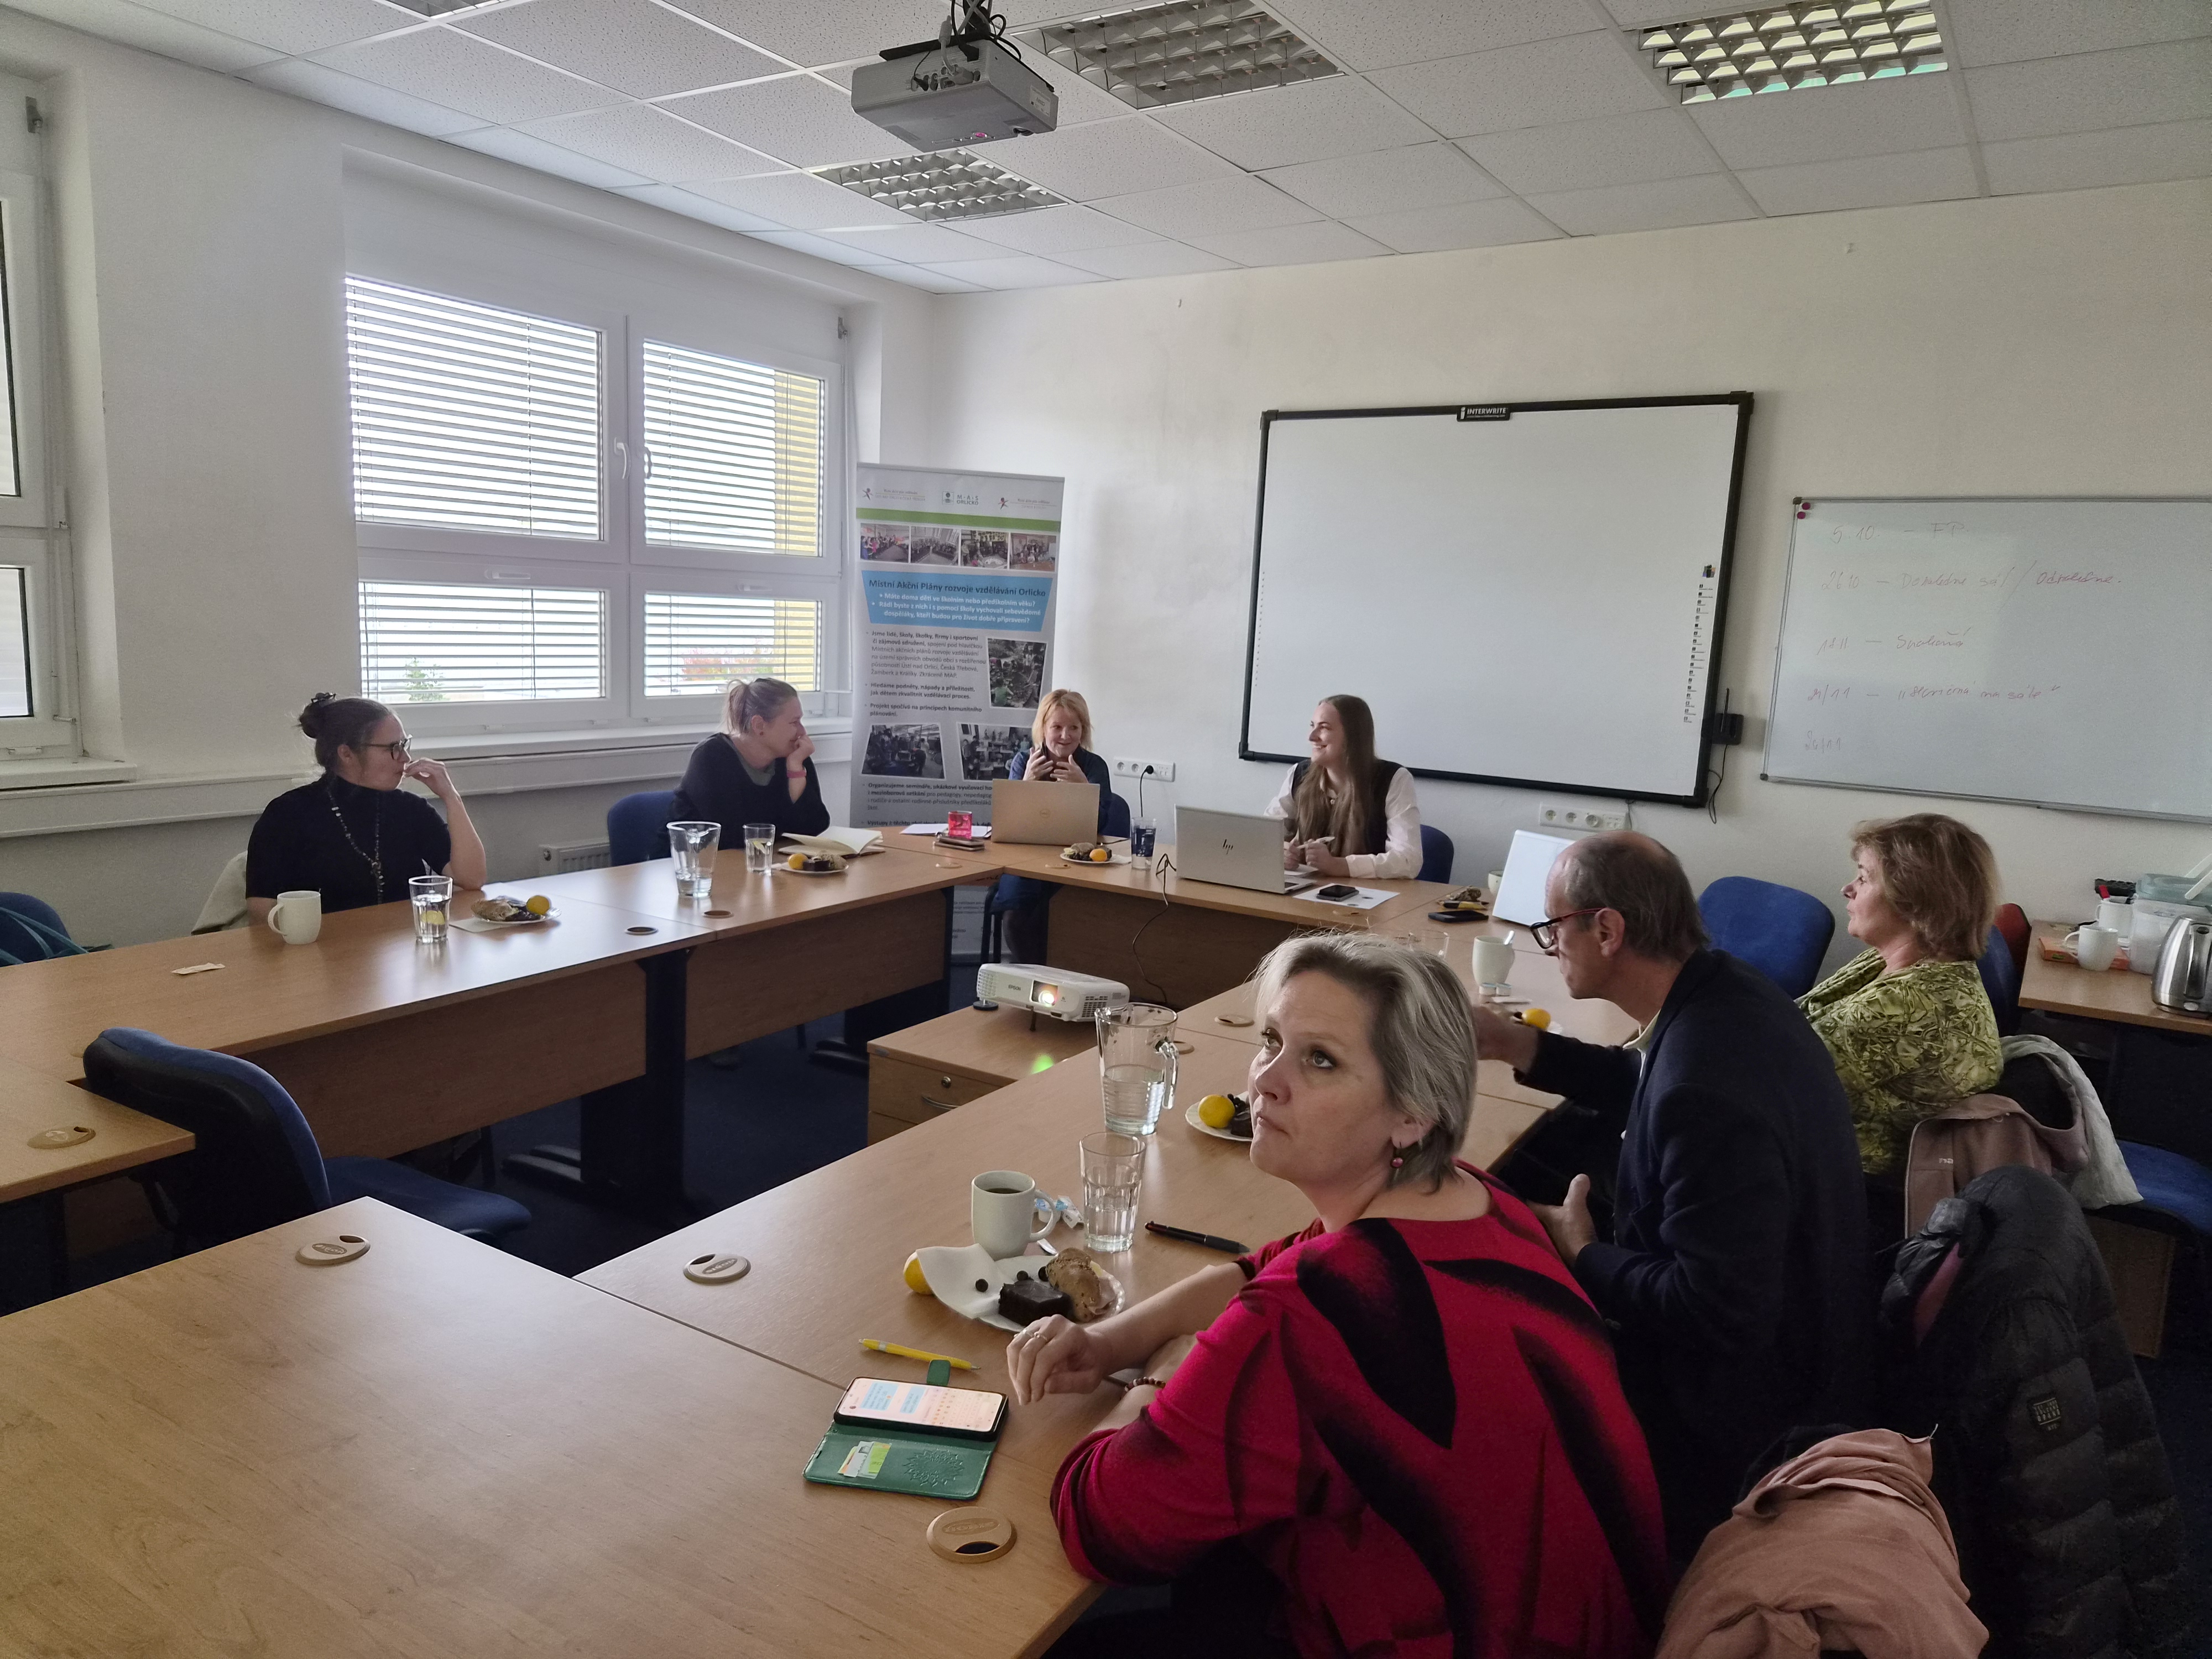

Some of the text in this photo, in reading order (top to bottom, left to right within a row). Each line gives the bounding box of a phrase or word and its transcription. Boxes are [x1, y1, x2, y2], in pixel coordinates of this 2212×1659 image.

[869, 580, 1045, 596] Místní Akční Plány rozvoje vzdělávání Orlicko
